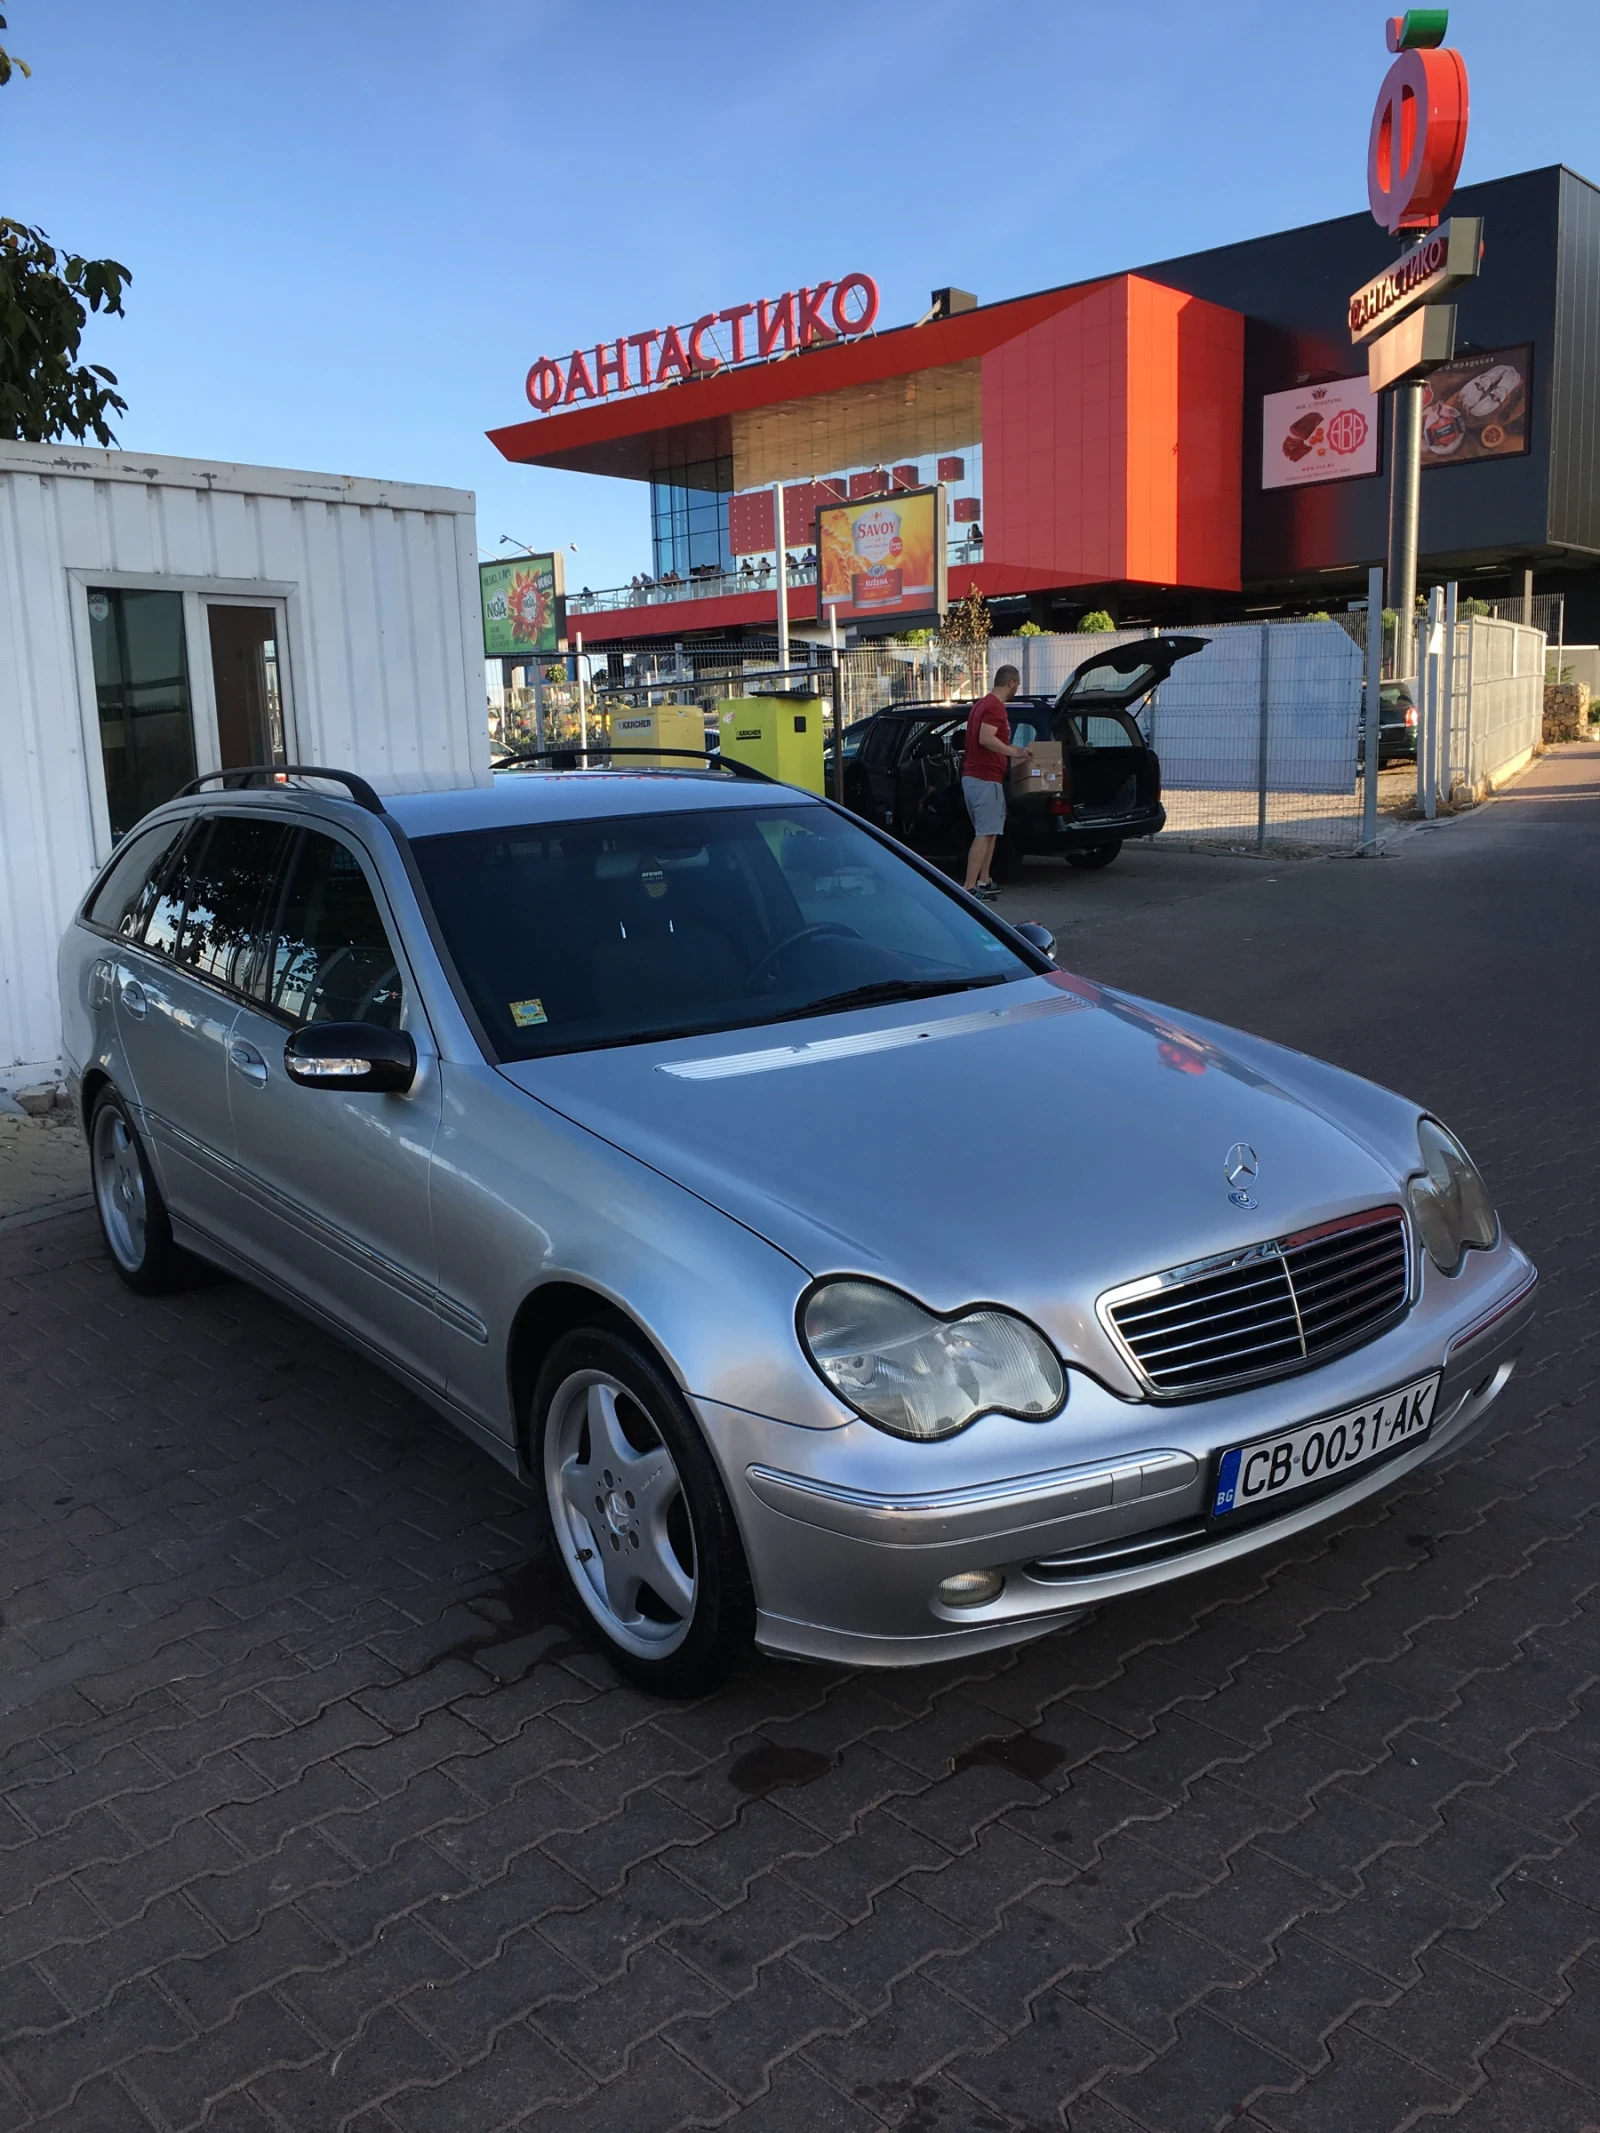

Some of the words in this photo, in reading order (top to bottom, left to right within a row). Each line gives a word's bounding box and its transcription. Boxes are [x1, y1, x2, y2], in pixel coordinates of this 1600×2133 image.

[526, 272, 880, 413] ФАНТАСТИКО
[857, 521, 896, 541] SAVOY
[1242, 1443, 1293, 1496] CB
[1302, 1406, 1384, 1477] 0031
[1388, 1384, 1432, 1441] AK
[1217, 1488, 1234, 1506] BG
